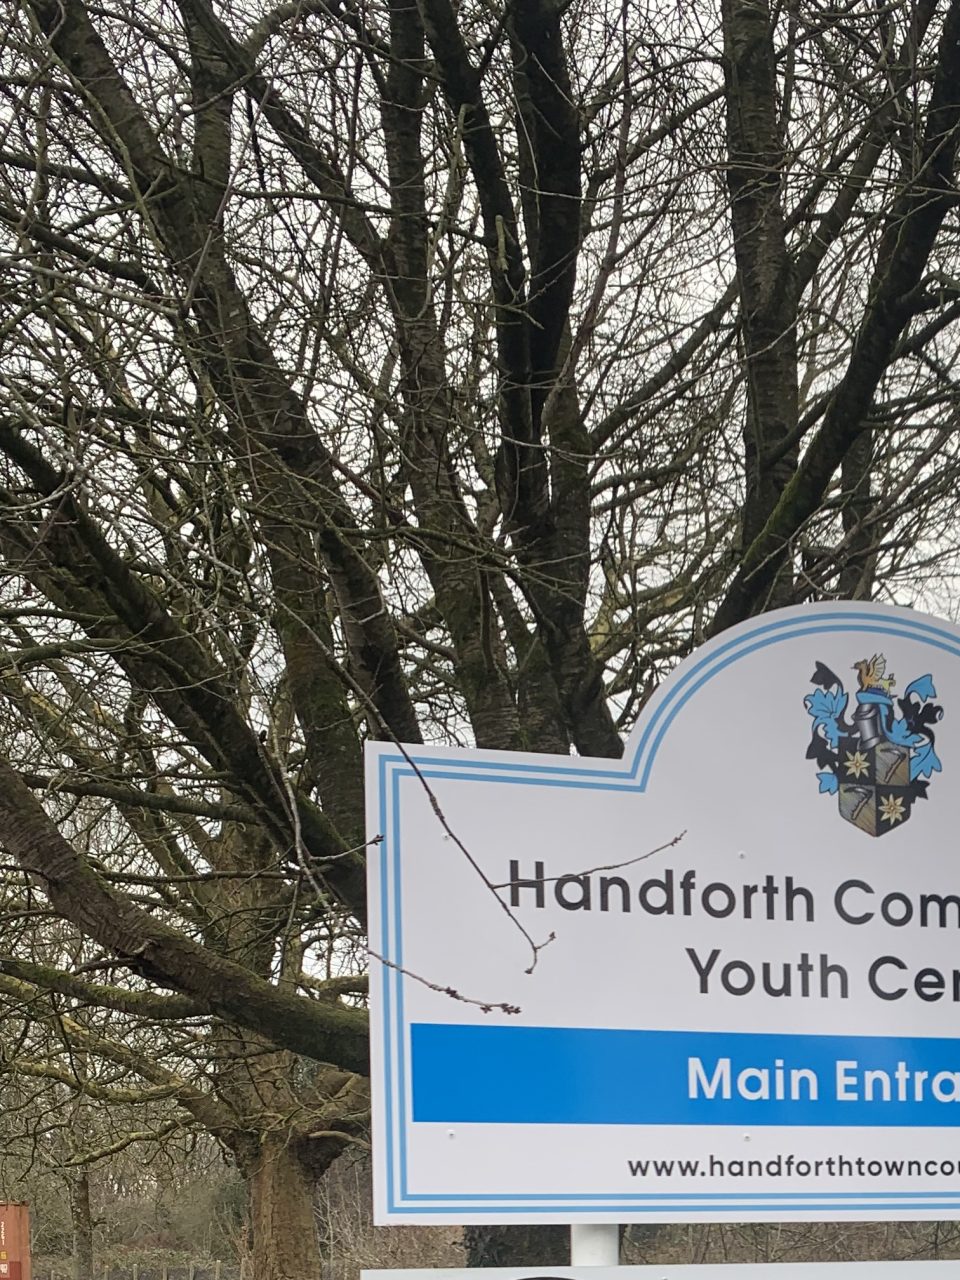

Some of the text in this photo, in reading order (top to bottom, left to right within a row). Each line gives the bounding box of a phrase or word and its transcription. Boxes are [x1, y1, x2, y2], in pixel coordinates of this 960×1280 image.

[509, 859, 814, 922] Handforth
[685, 947, 848, 999] Youth
[688, 1057, 818, 1101] Main
